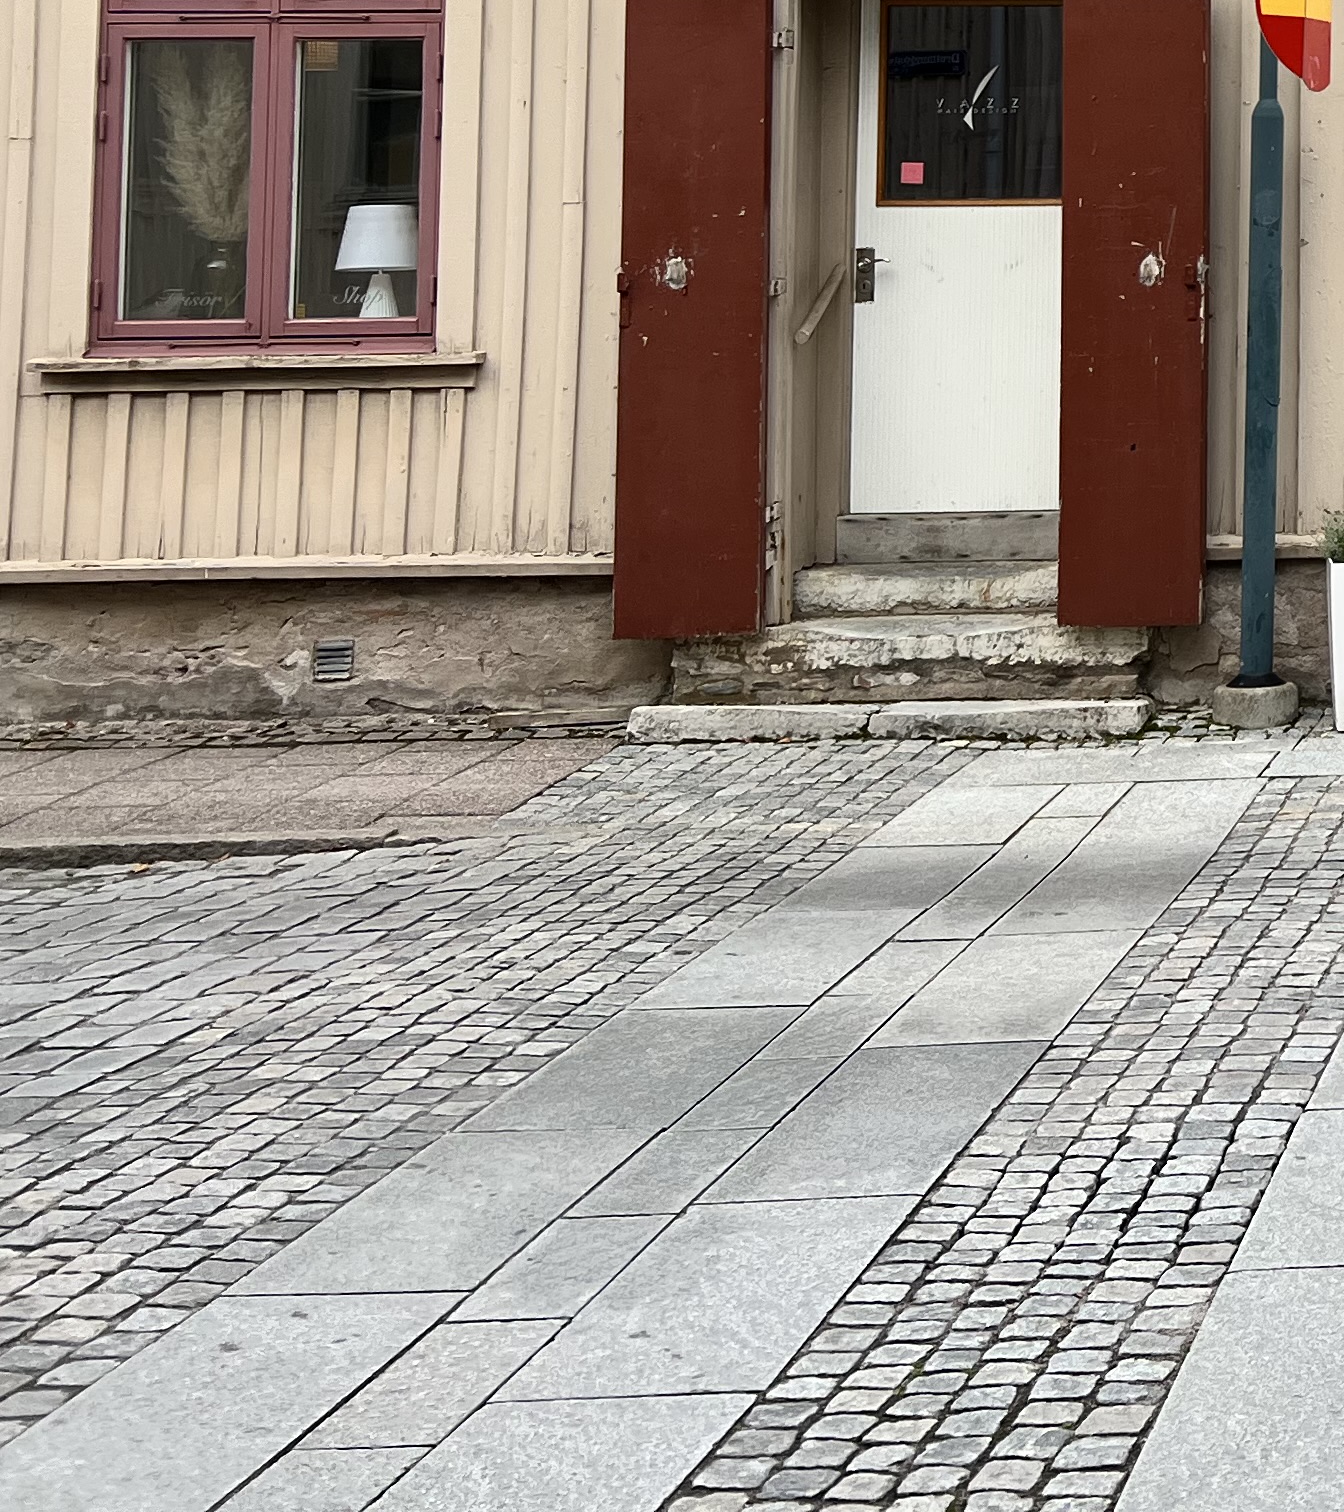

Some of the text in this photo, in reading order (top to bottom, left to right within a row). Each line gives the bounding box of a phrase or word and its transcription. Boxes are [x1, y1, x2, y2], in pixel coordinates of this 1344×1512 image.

[936, 97, 1020, 108] VAZZ
[155, 288, 223, 311] Frisör
[333, 285, 384, 310] Shop
